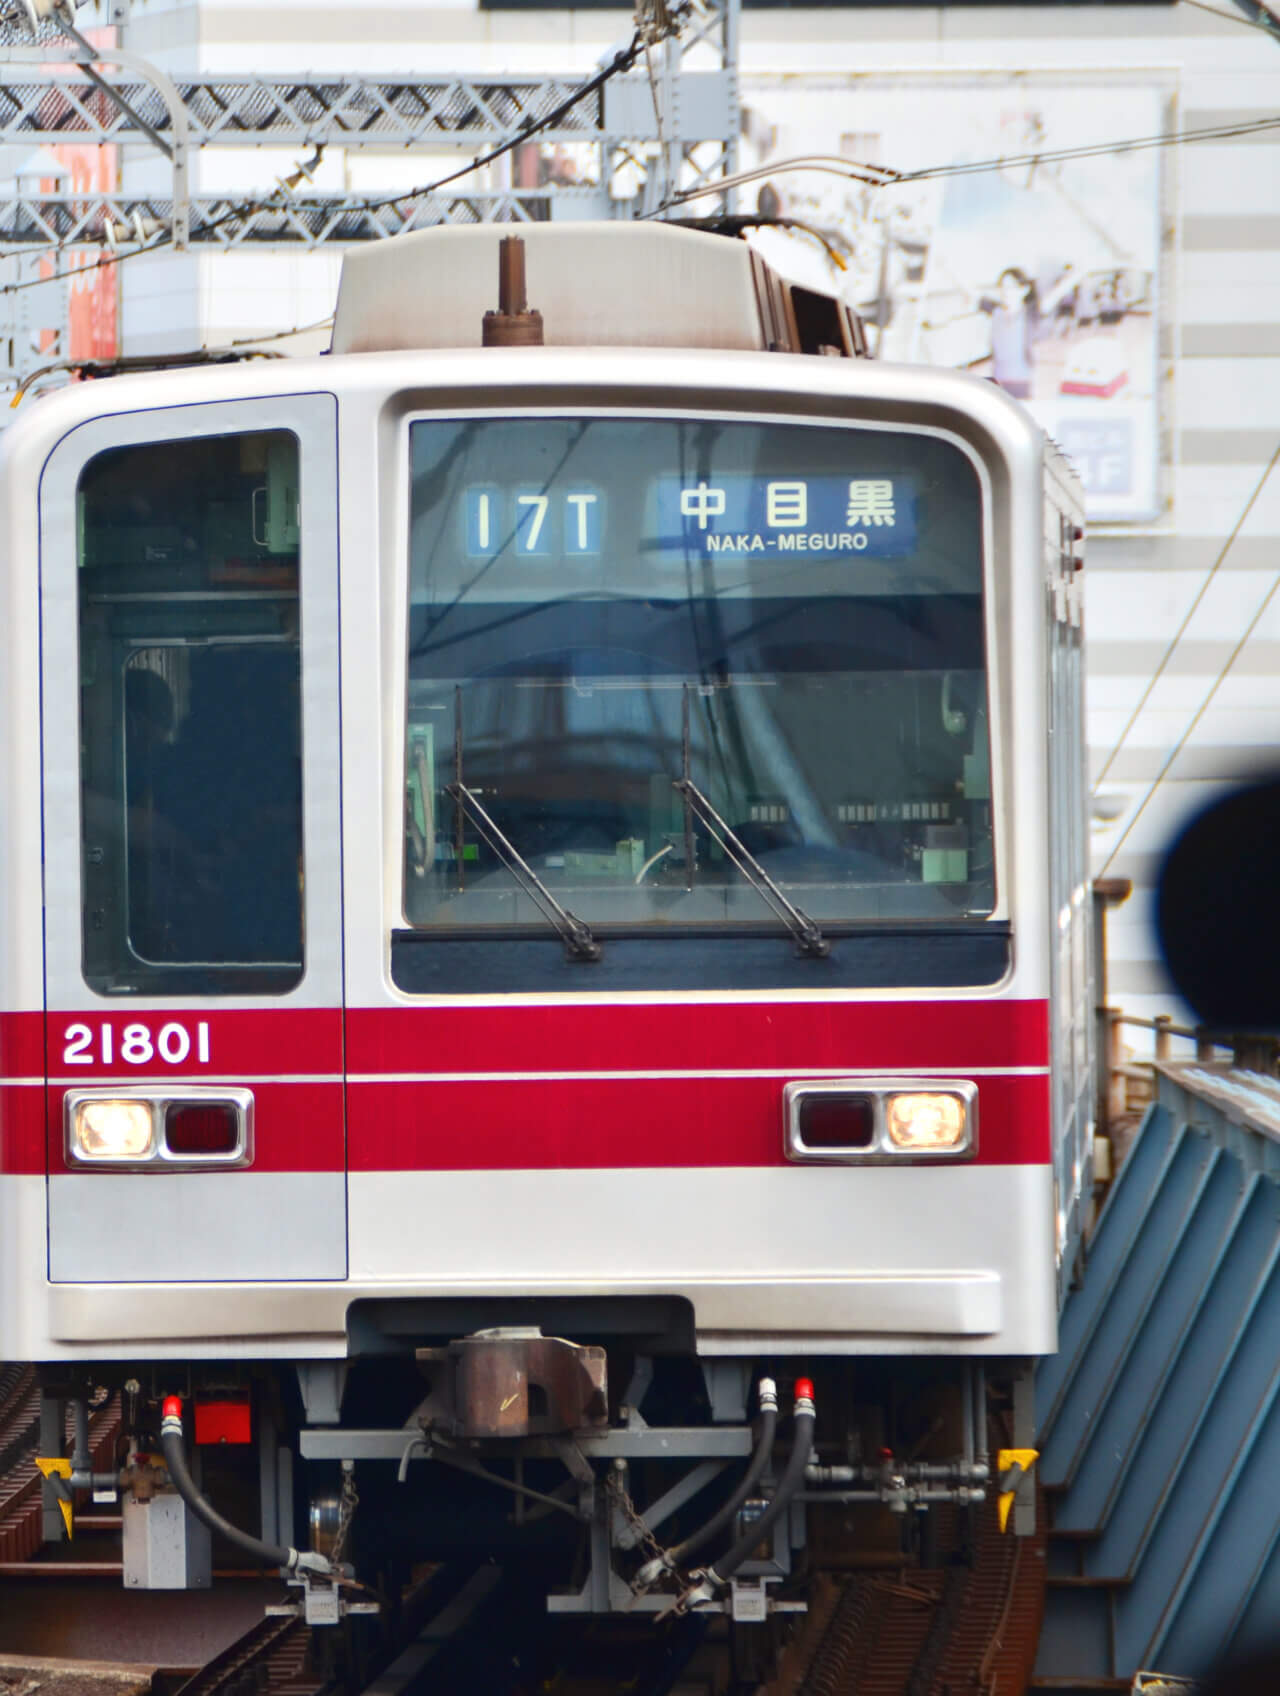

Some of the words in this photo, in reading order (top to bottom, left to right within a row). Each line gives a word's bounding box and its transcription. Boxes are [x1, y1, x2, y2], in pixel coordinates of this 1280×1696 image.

[479, 494, 597, 550] 17T
[681, 479, 896, 530] 中目黒
[706, 532, 869, 552] NAKA-MEGURO
[63, 1021, 210, 1064] 21801
